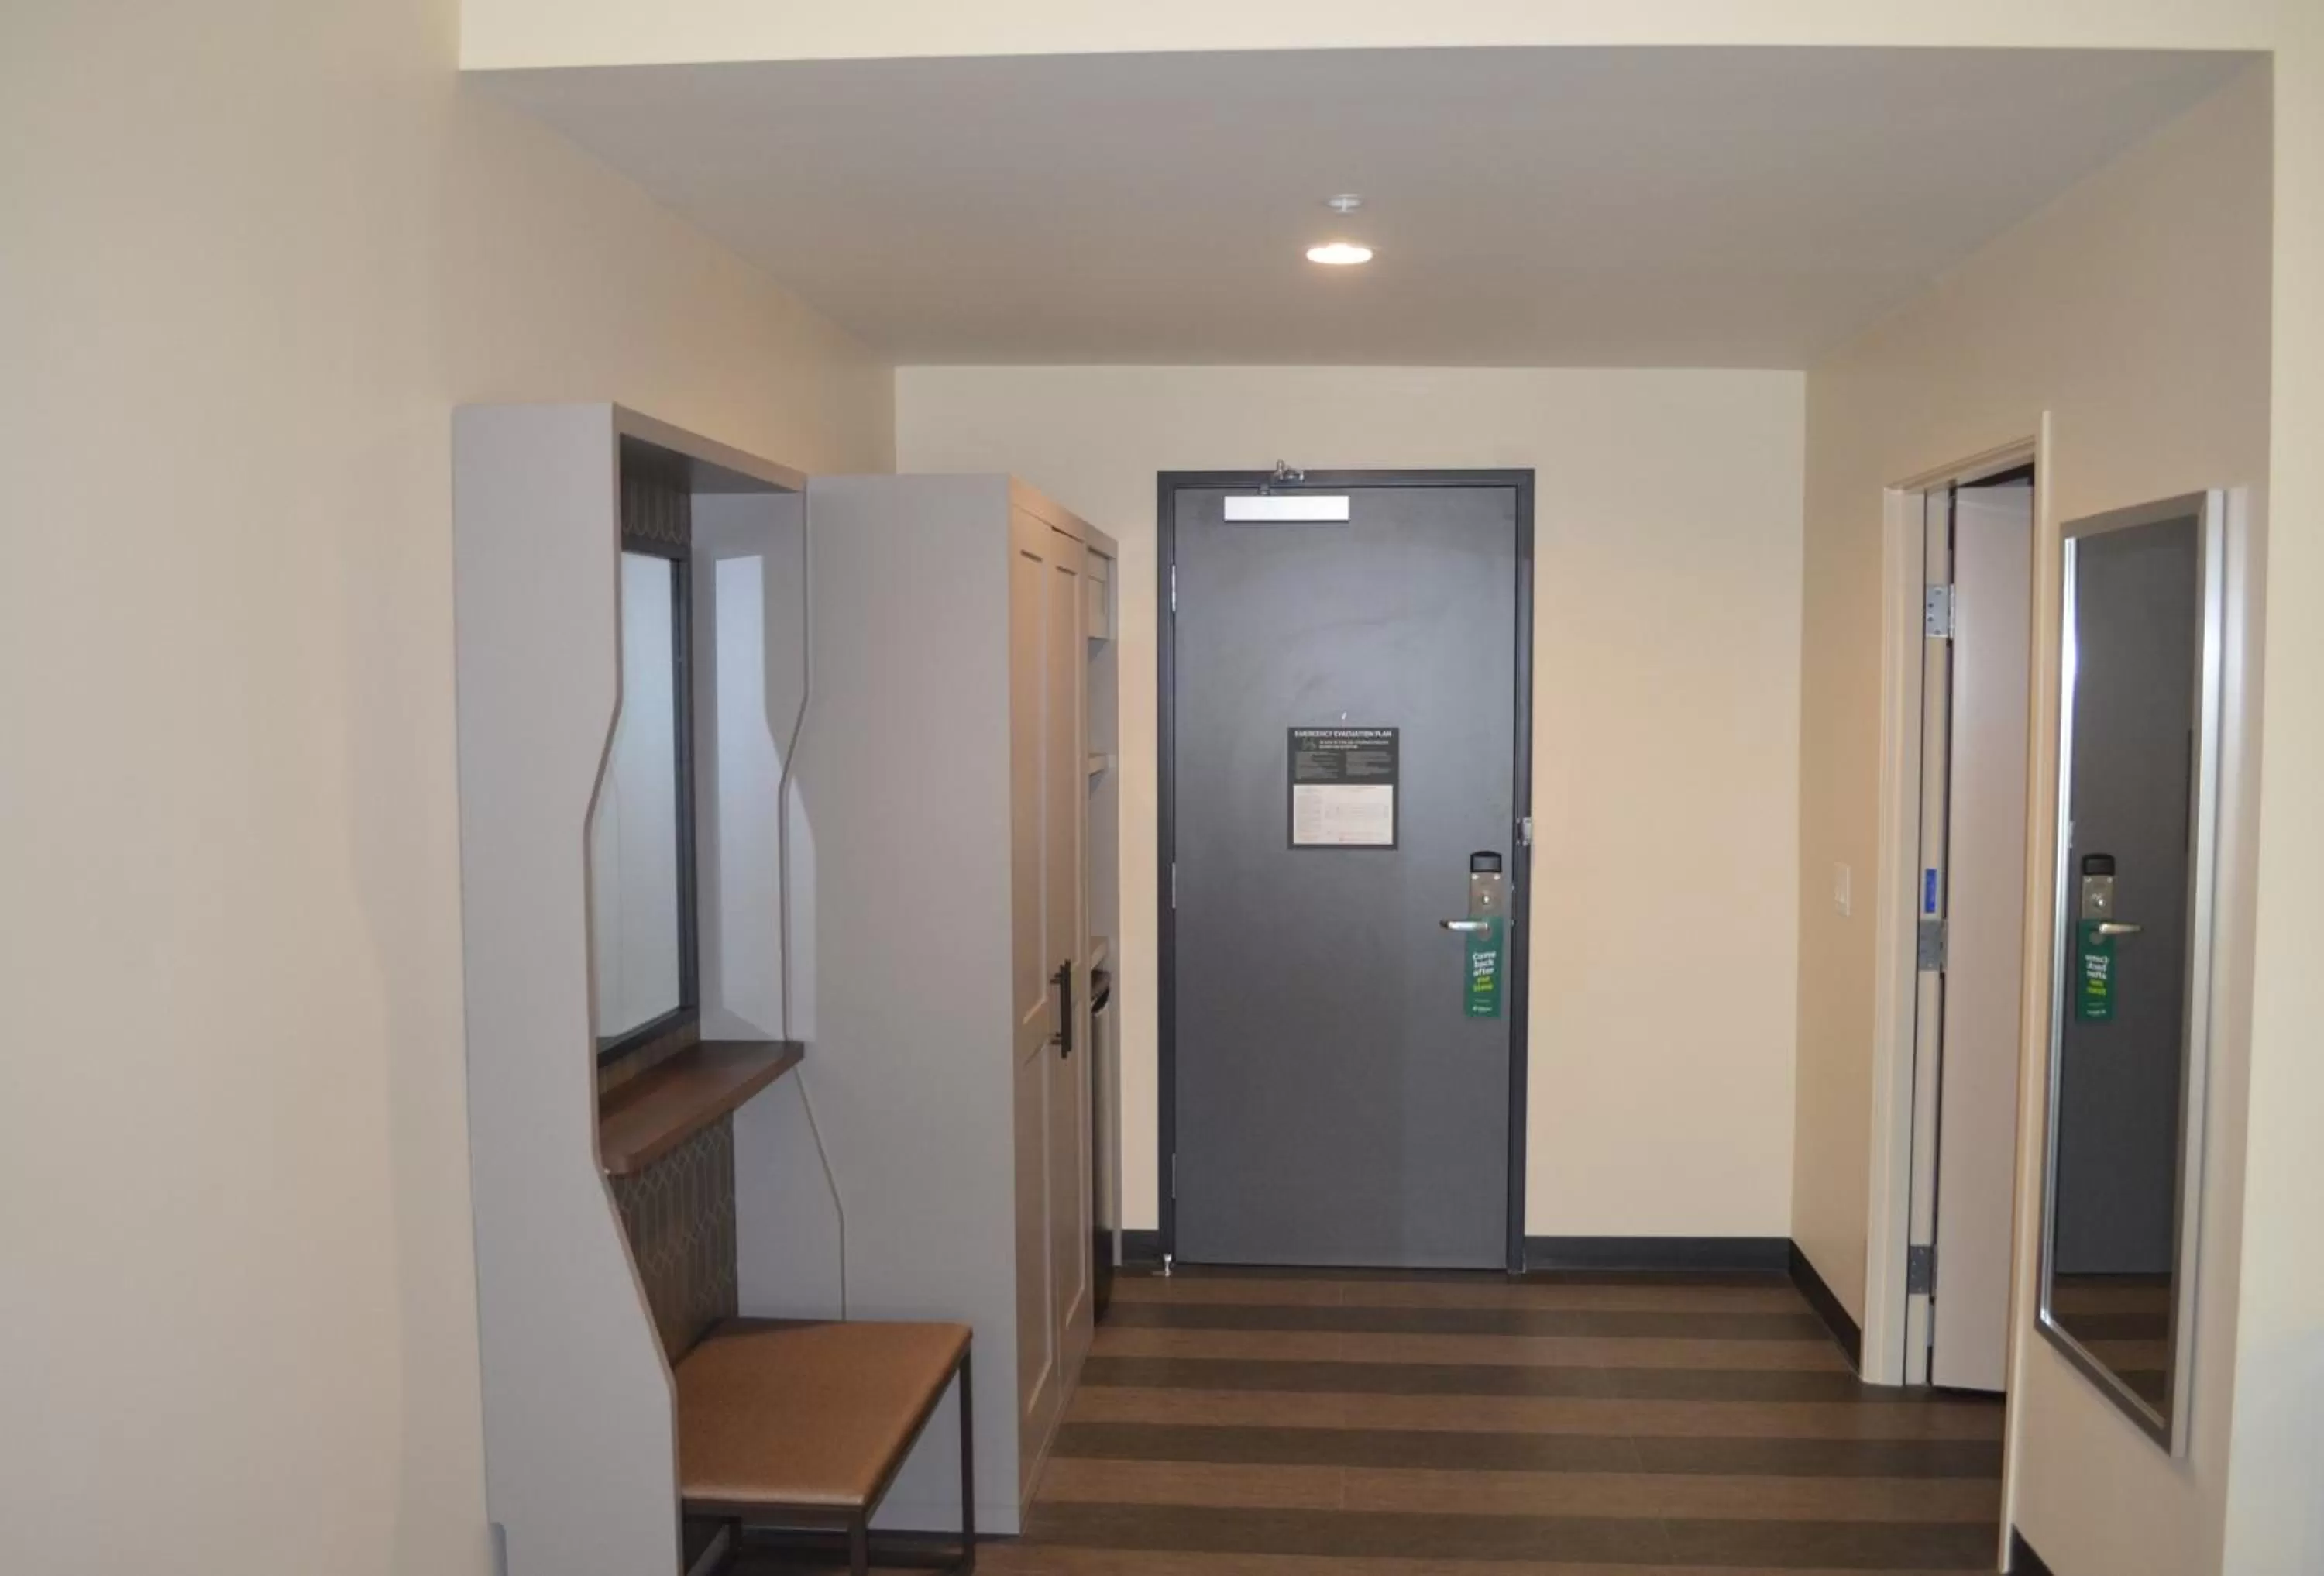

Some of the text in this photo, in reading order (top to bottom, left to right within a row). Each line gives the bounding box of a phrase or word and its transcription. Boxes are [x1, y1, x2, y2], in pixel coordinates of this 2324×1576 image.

[1473, 951, 1496, 960] Come
[1474, 959, 1494, 968] back
[1473, 968, 1494, 977] after
